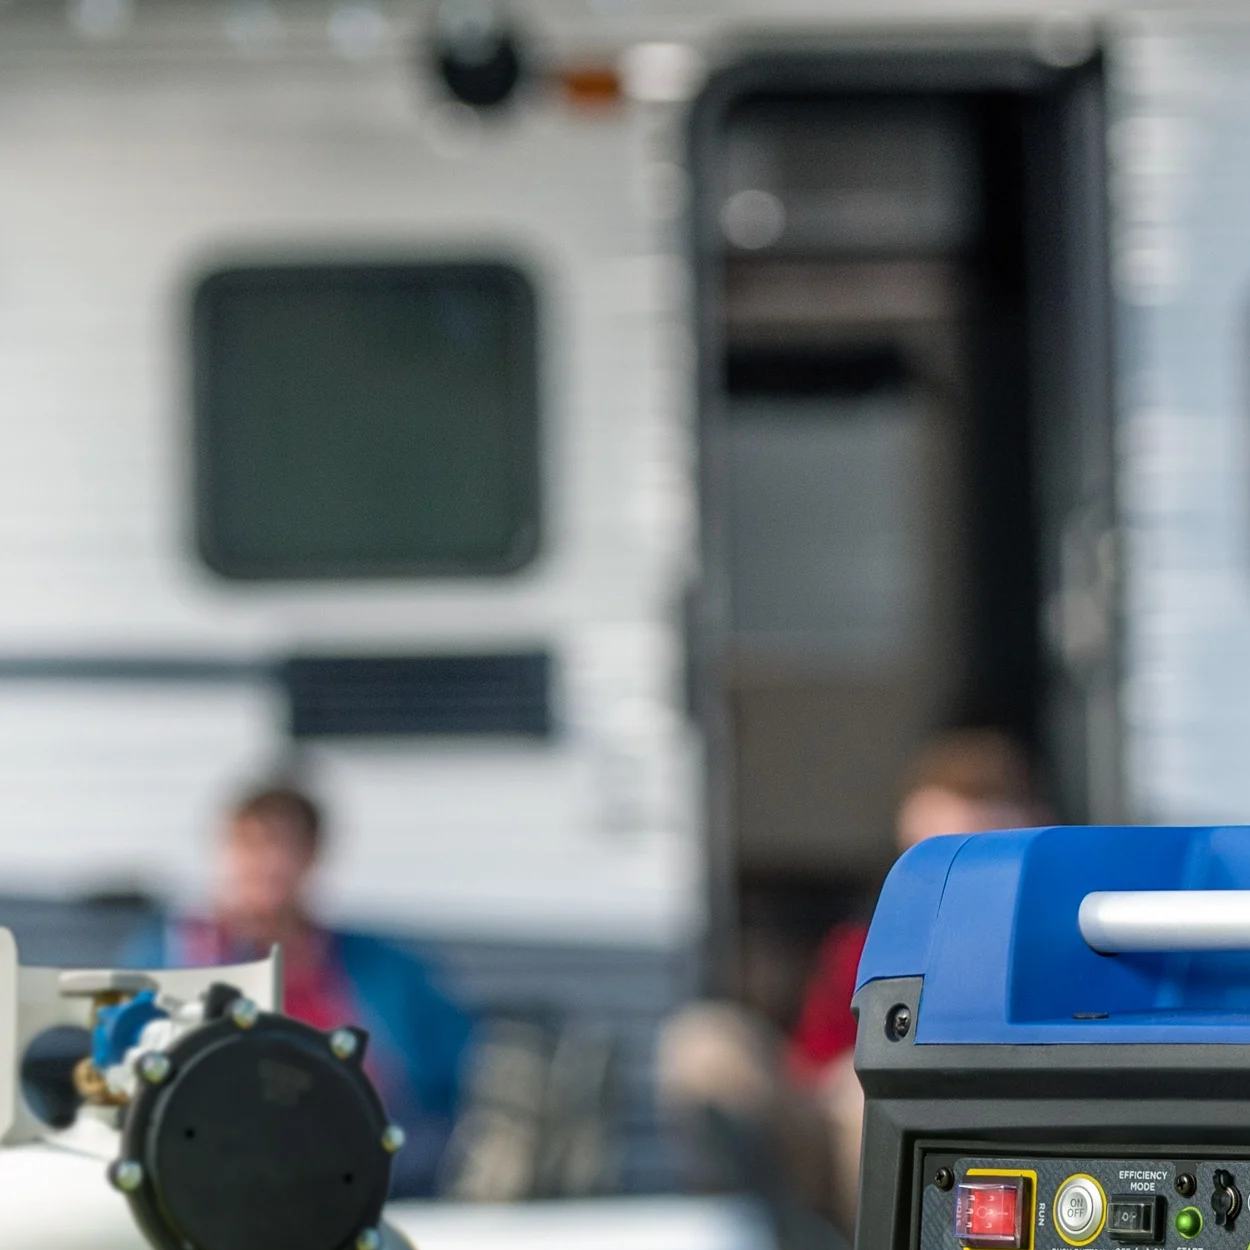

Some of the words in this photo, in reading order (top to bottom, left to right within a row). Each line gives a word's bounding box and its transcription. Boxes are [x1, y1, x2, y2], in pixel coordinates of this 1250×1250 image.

[1119, 1171, 1168, 1180] EFFICIENCY
[1130, 1182, 1155, 1191] MODE
[1070, 1199, 1083, 1207] ON
[1038, 1203, 1046, 1226] RUN
[1067, 1209, 1085, 1218] OFF
